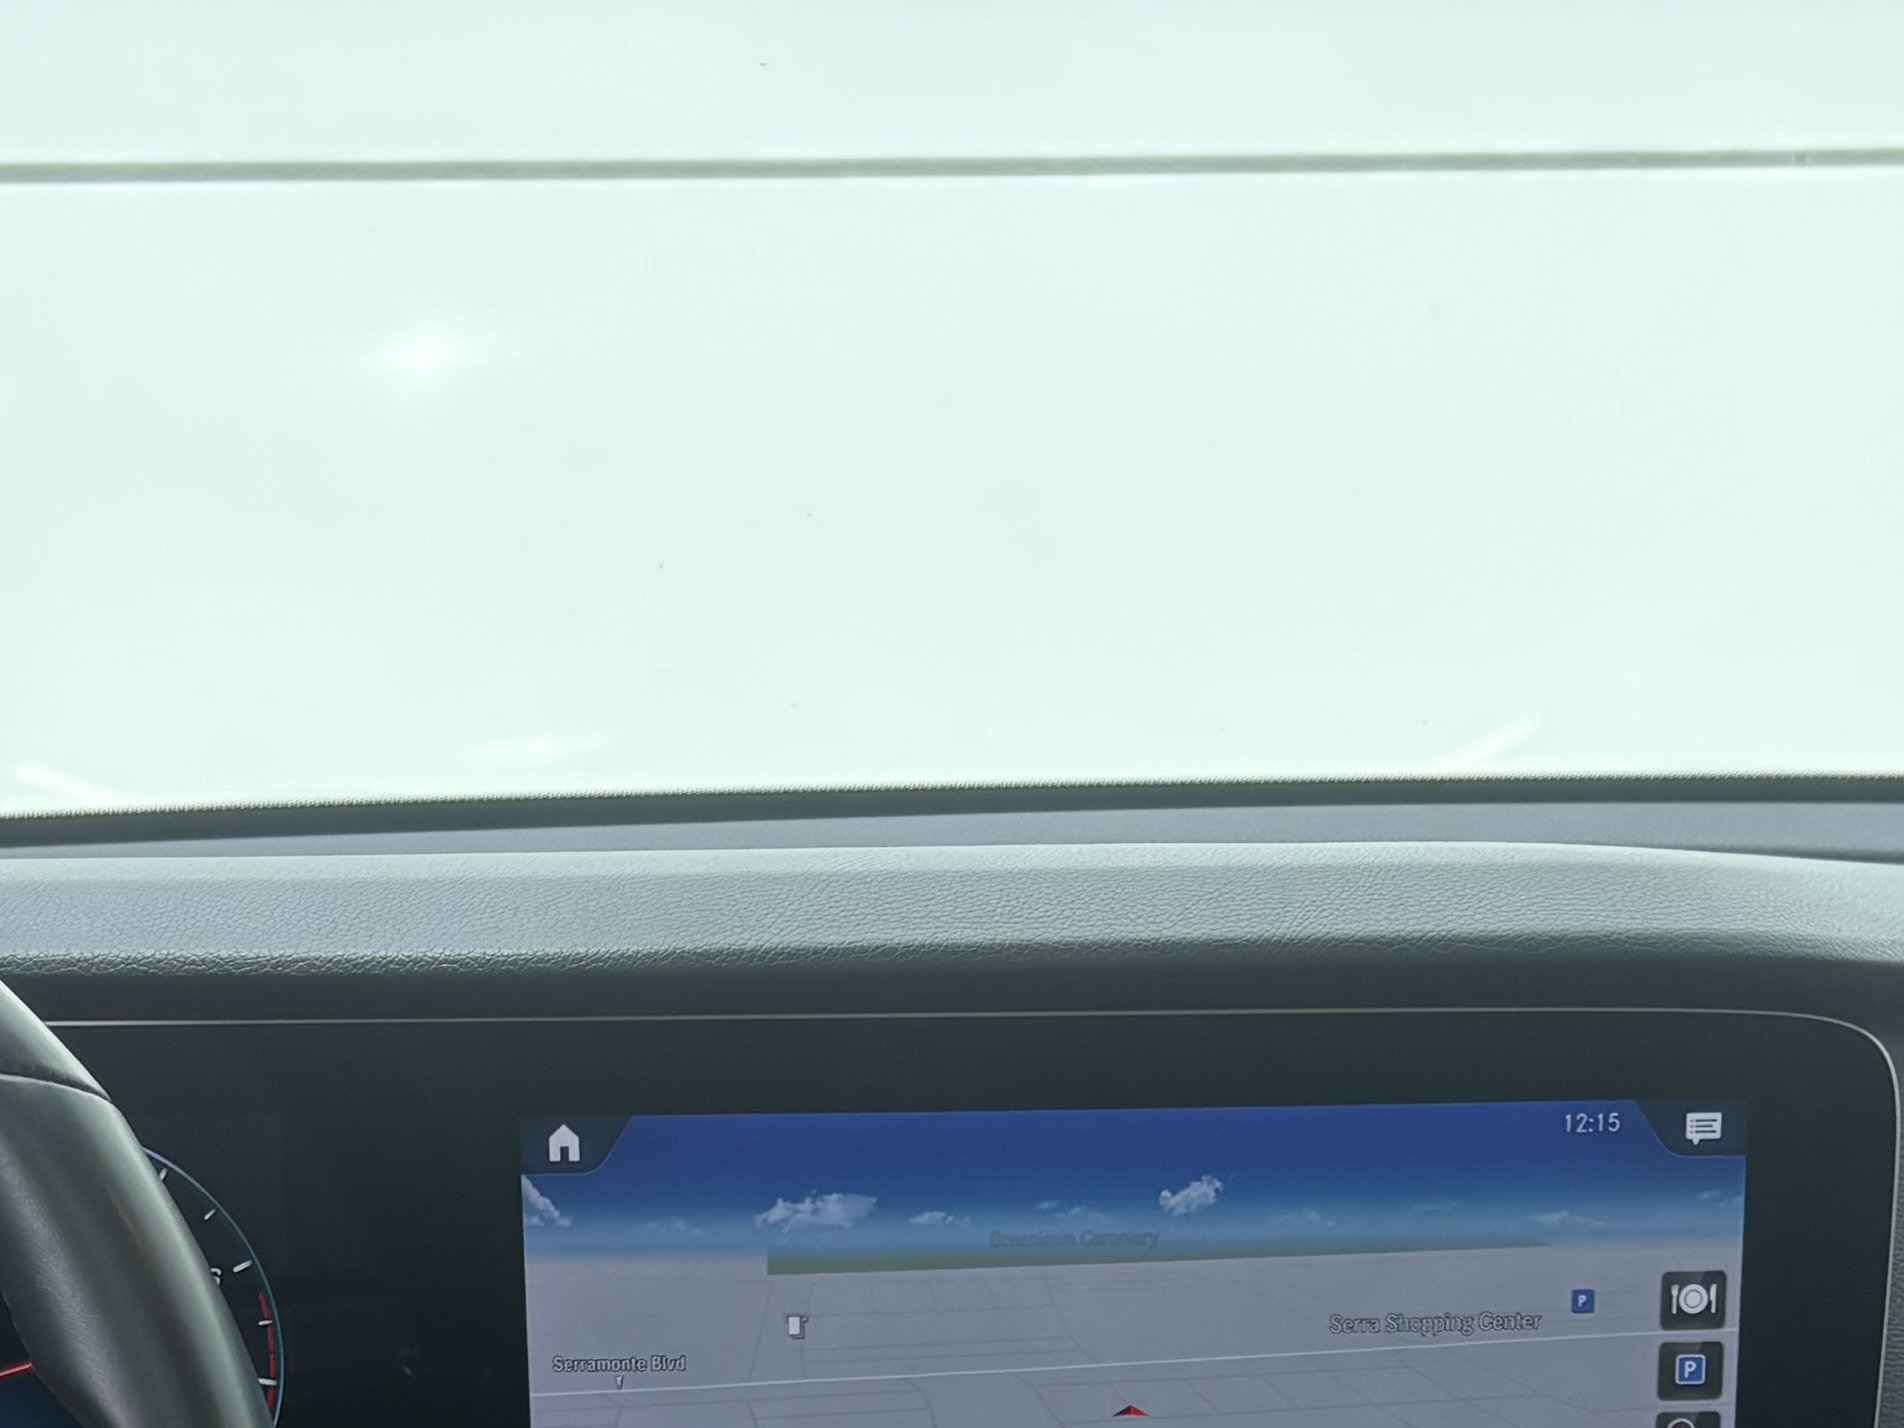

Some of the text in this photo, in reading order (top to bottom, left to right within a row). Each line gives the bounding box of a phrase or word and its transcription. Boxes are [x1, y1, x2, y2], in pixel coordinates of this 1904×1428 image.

[1564, 1112, 1621, 1134] 12:15
[1329, 1311, 1542, 1337] Serra Shopping Center
[553, 1354, 687, 1373] Serramonte Blvd
